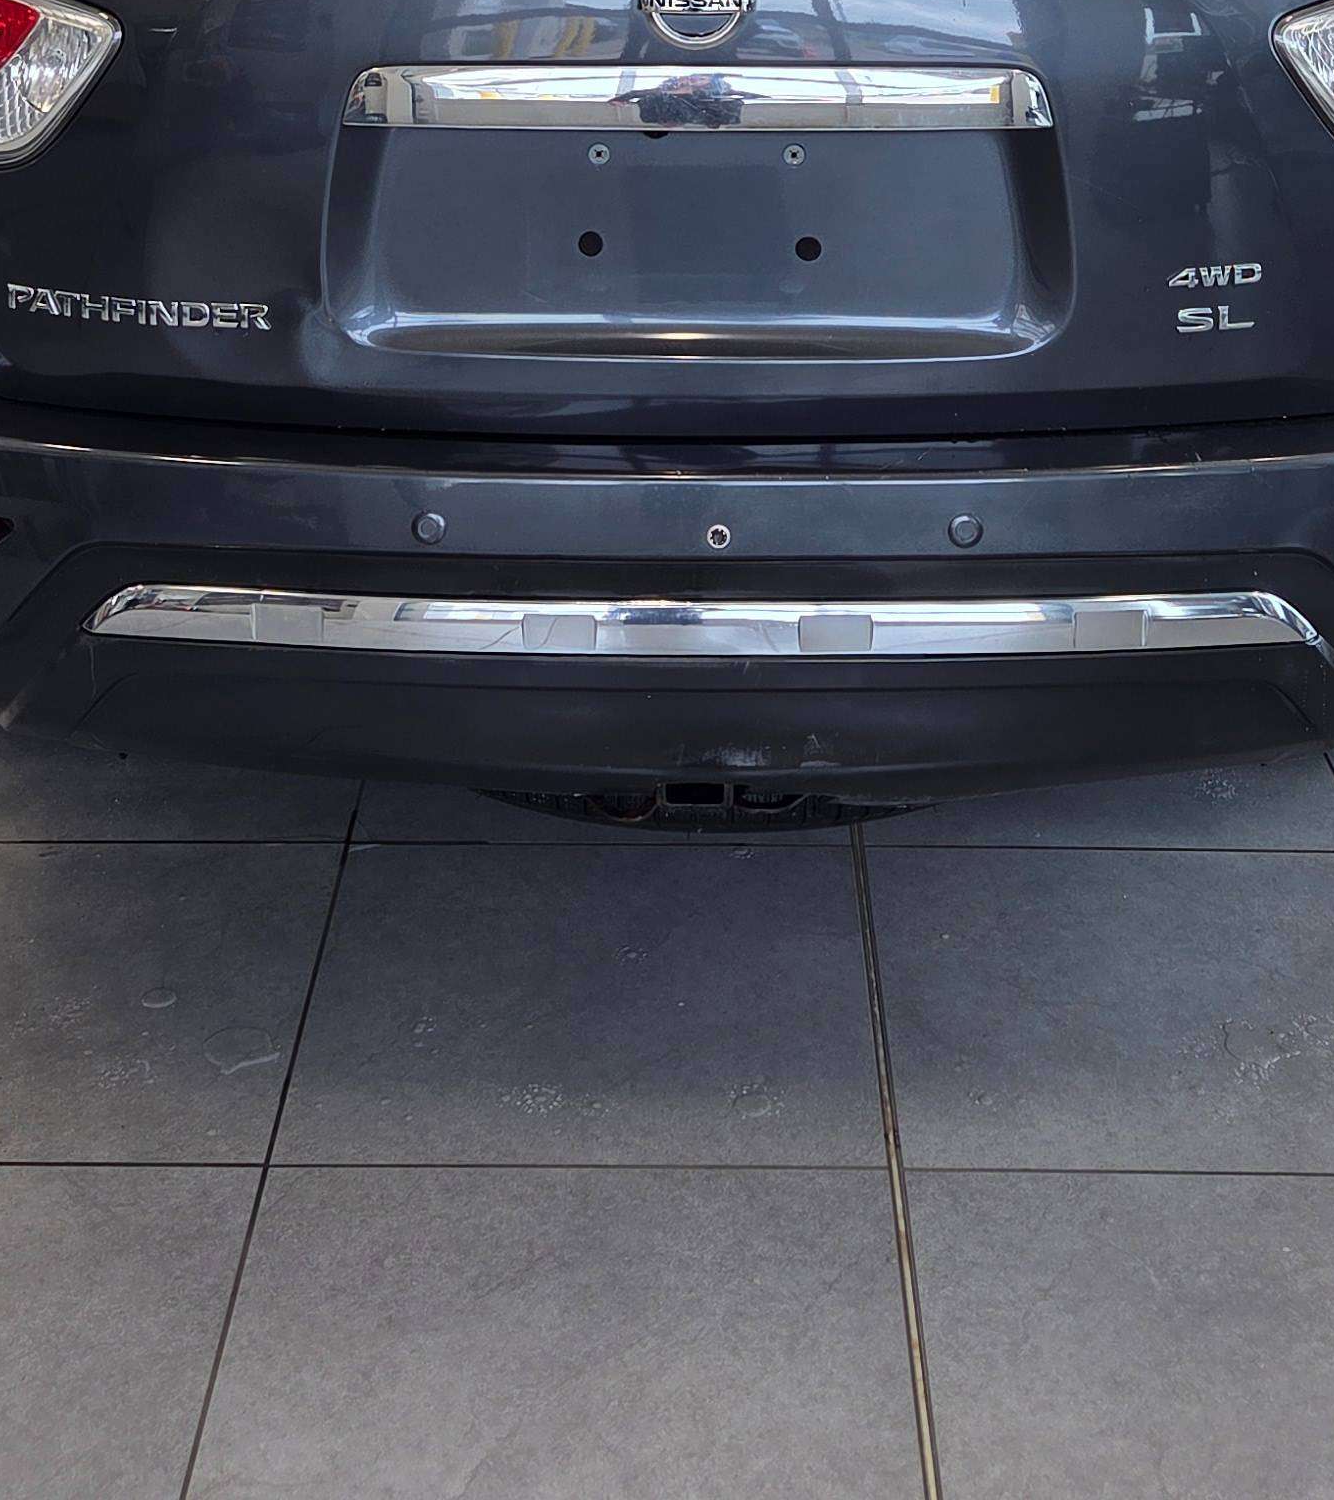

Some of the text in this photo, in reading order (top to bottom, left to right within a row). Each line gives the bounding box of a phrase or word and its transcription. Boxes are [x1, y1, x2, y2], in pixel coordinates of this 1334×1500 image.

[1168, 263, 1262, 289] 4WD
[6, 282, 272, 331] PATHFINDER
[1176, 305, 1255, 333] SL
